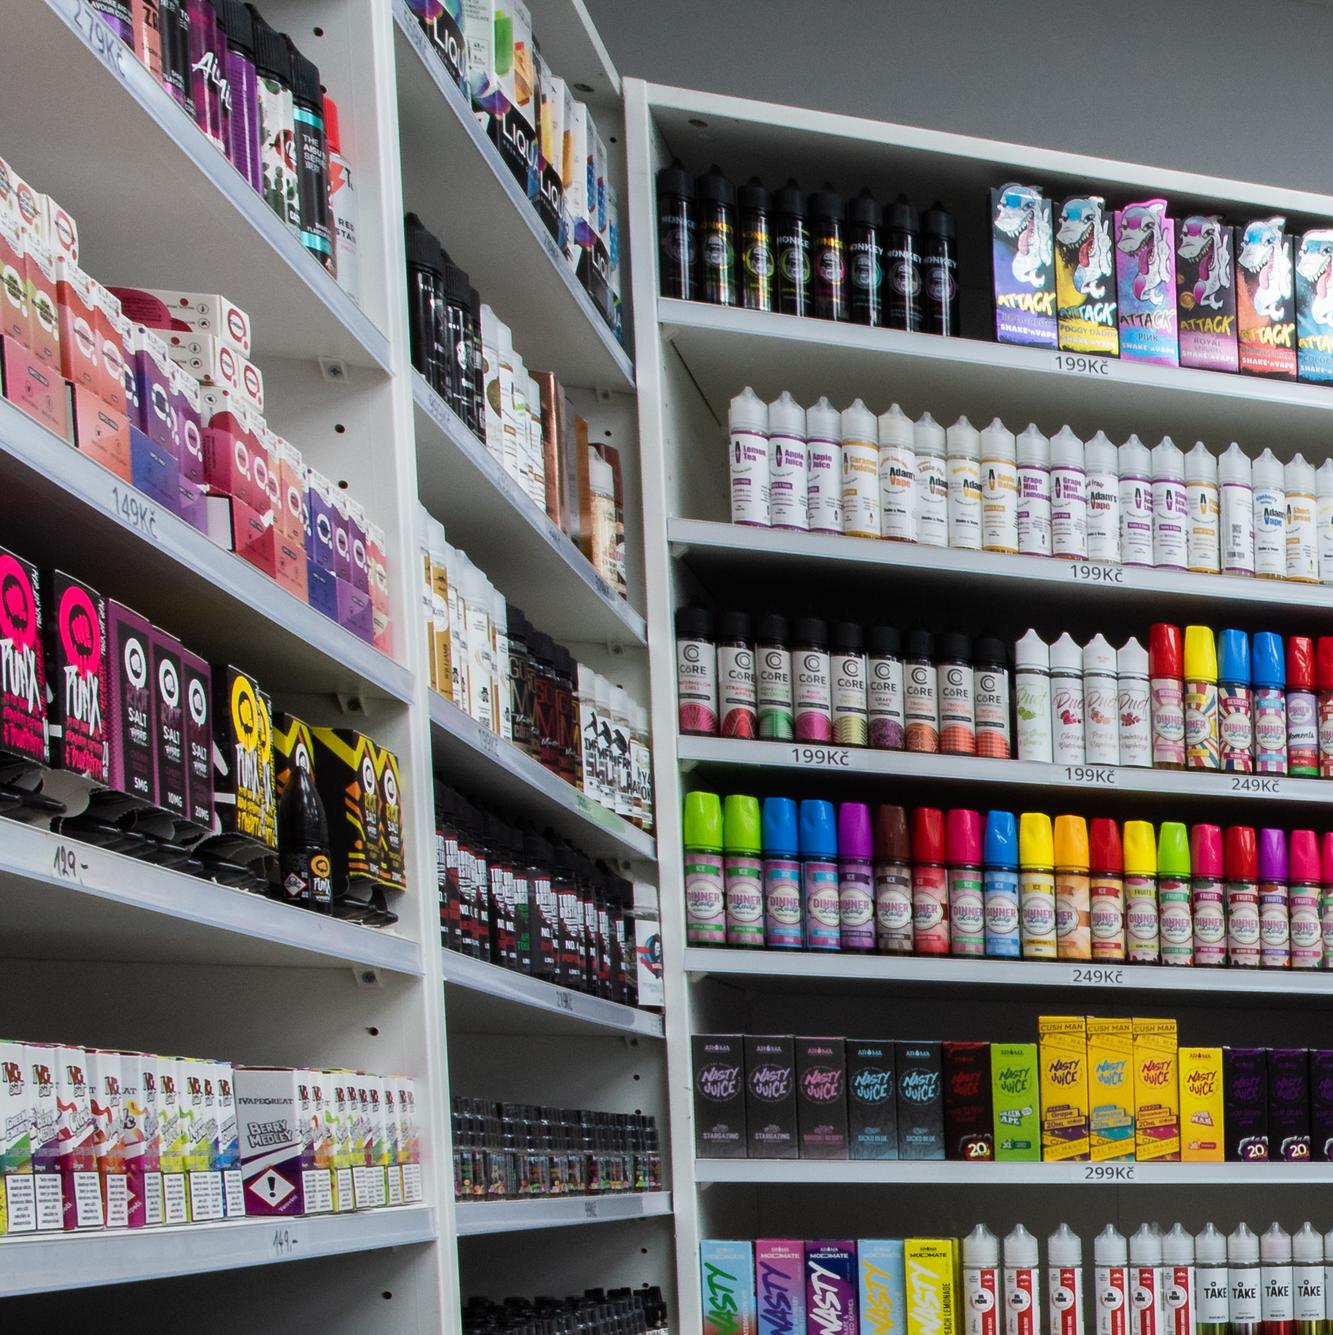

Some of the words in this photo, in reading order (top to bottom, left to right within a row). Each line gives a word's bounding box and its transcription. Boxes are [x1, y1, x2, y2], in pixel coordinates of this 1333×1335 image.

[502, 110, 539, 172] LIQUA
[998, 292, 1055, 316] ATTACK
[1180, 315, 1234, 335] ATTACK
[1055, 356, 1109, 375] 199Kč
[111, 487, 158, 539] 149Kč
[1070, 564, 1124, 583] 199Kč
[0, 638, 42, 714] PUNX
[64, 665, 103, 737] PUNX
[792, 748, 849, 766] 199Kč
[1064, 766, 1115, 784] 199Kč
[134, 777, 148, 793] 5MG
[1231, 777, 1280, 792] 249Kč
[1072, 968, 1123, 984] 249Kč
[1134, 1024, 1154, 1033] CUSH
[1155, 1024, 1176, 1033] MAN
[702, 1066, 739, 1084] NASTY
[1142, 1059, 1172, 1073] NASTY
[854, 1070, 890, 1086] NASTY
[1144, 1071, 1169, 1085] JUICE
[704, 1081, 736, 1099] JUICE
[856, 1083, 887, 1101] JUICE
[247, 1119, 288, 1136] BERRY
[247, 1130, 293, 1149] MEDLEY
[1084, 1165, 1135, 1180] 299Kč
[942, 1282, 951, 1313] LEMONADE
